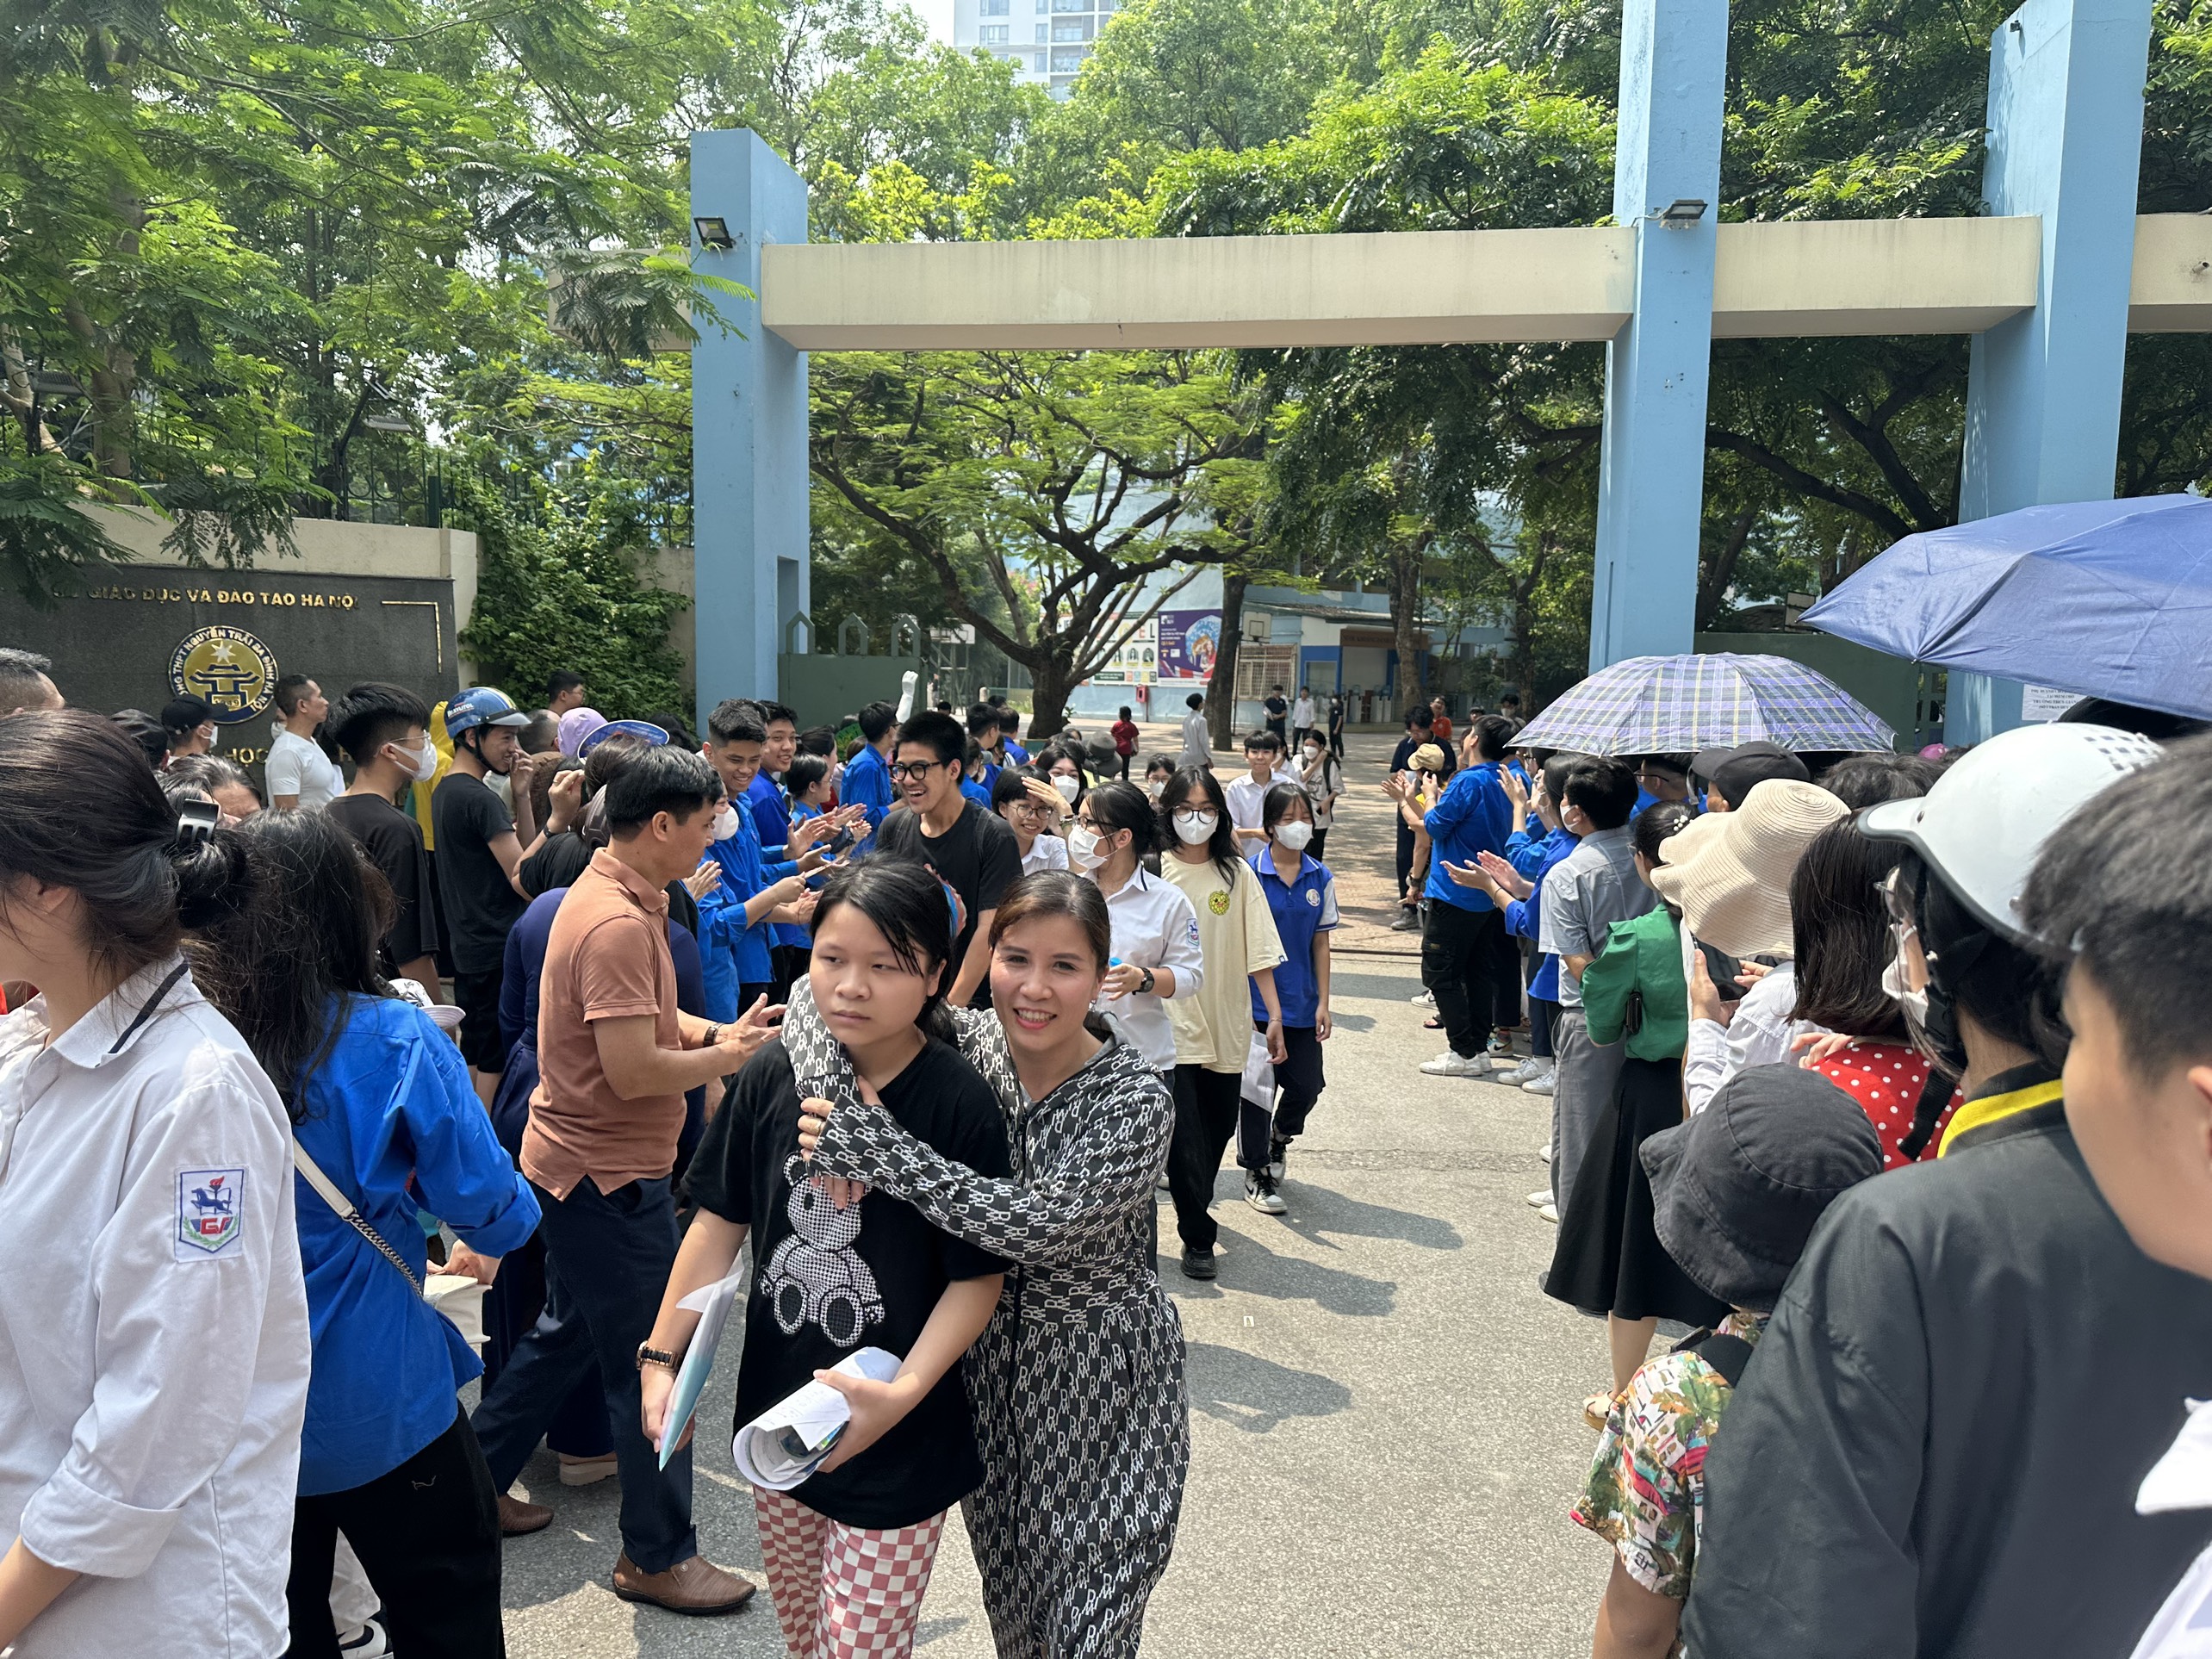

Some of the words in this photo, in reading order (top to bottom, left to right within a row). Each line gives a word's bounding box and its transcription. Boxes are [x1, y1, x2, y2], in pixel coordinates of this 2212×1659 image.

[88, 584, 136, 600] GIÁO
[142, 588, 181, 604] DỤC
[186, 587, 212, 603] VÀ
[217, 588, 255, 605] ĐÀO
[259, 593, 295, 608] TẠO
[173, 648, 187, 674] THPT
[183, 626, 226, 651] NGUYỄN
[252, 643, 265, 657] BA
[224, 748, 269, 767] HỌC
